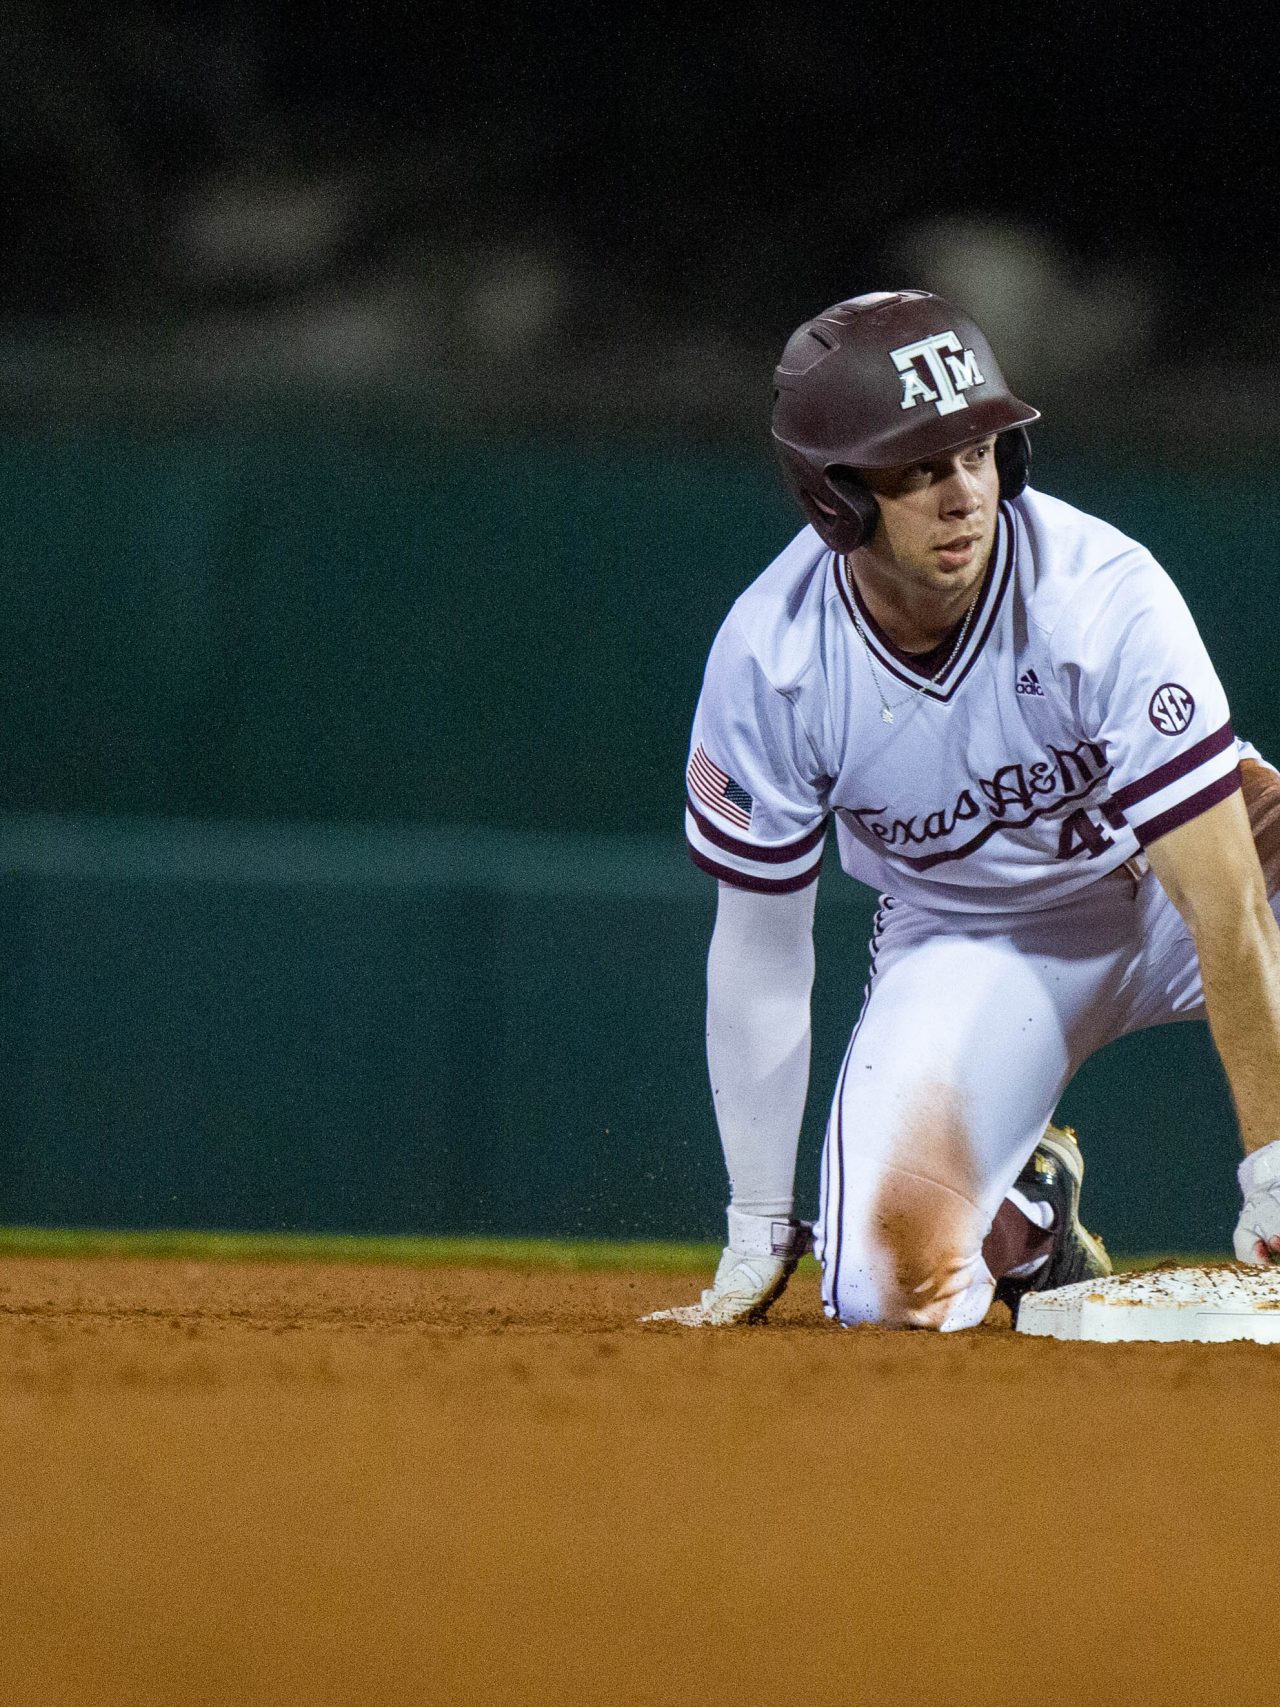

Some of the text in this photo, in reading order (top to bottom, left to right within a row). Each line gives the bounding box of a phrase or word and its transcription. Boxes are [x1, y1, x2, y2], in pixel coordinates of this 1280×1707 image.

[1152, 687, 1192, 732] SEC
[832, 741, 1114, 845] Texas A&M
